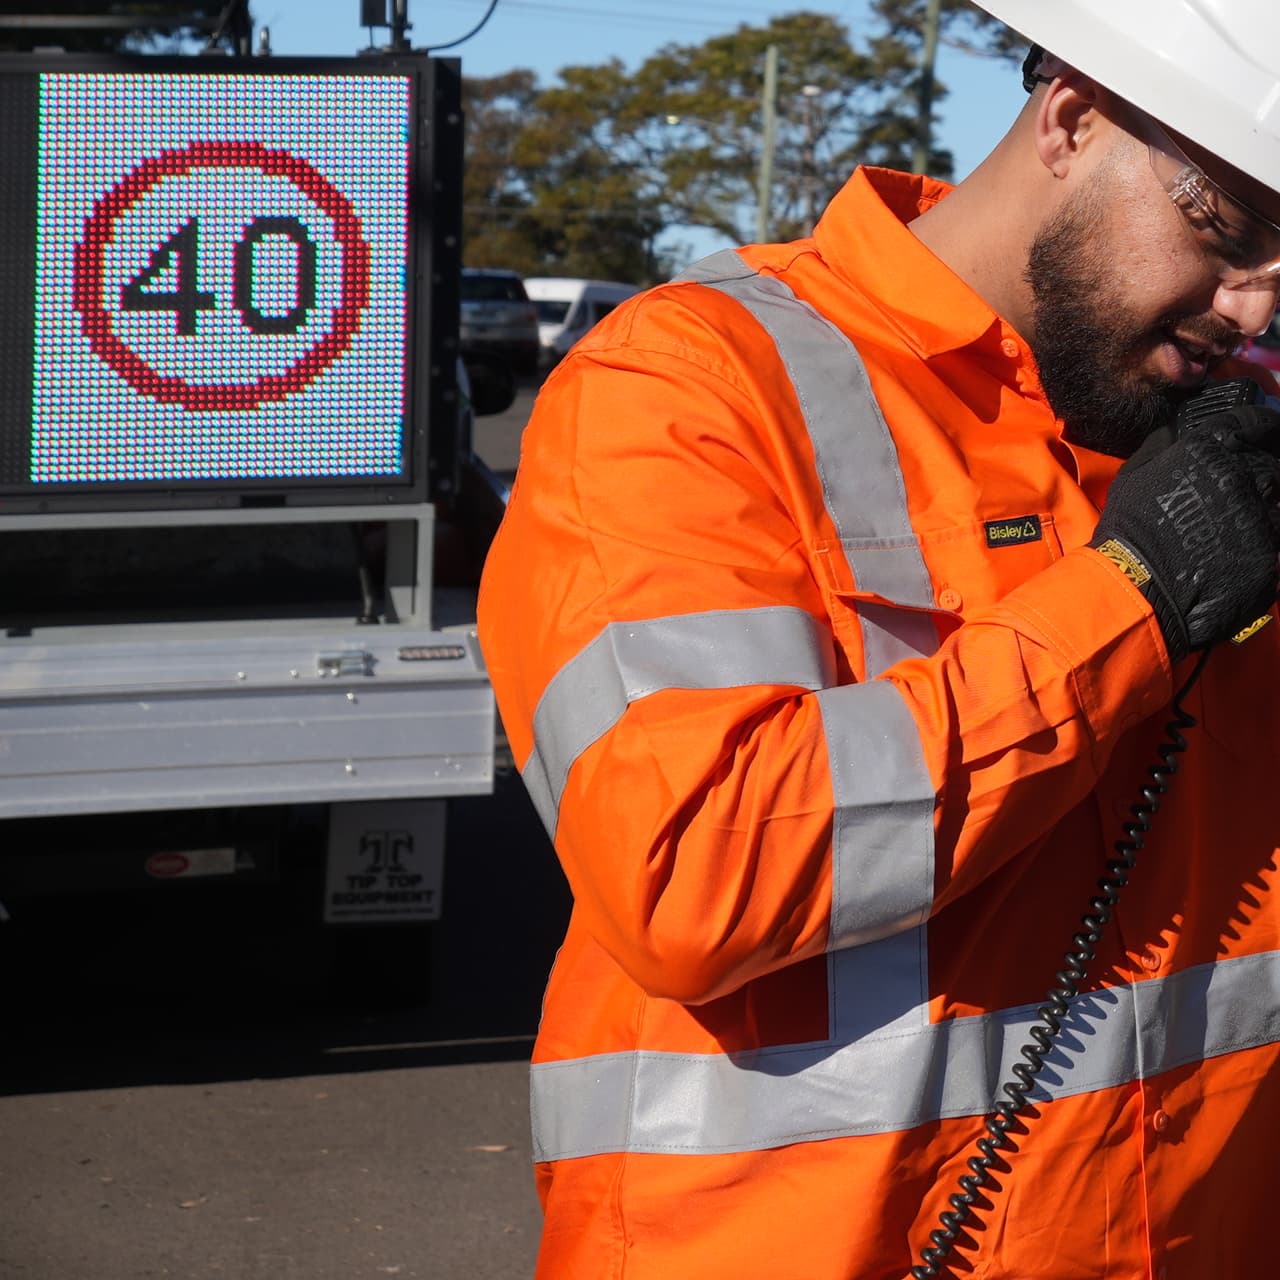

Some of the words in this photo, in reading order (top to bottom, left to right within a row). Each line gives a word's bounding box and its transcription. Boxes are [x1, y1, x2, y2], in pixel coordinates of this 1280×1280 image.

[121, 216, 317, 337] 40
[989, 524, 1023, 540] Bisley
[345, 874, 377, 889] TIP
[386, 874, 423, 888] TOP
[332, 890, 435, 906] EQUIPMENT
